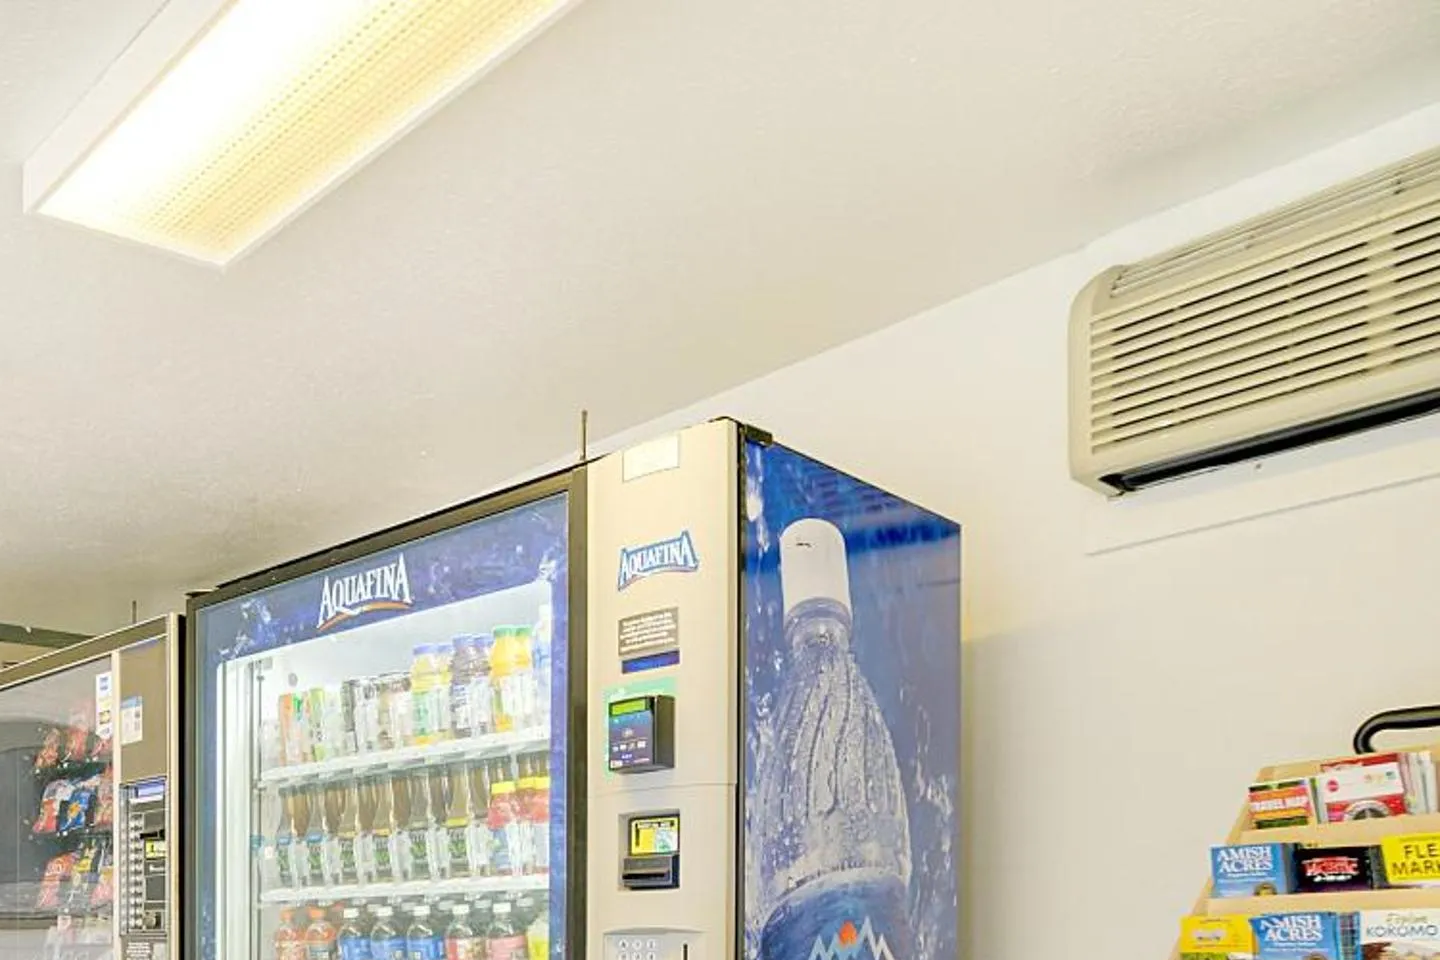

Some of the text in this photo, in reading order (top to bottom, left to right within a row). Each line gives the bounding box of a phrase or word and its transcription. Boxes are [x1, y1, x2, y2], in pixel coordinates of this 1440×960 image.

[619, 530, 698, 591] AQUAFINA
[317, 552, 413, 629] AQUAFINA
[1217, 846, 1272, 861] AMISH
[1404, 846, 1440, 859] FLE
[1219, 858, 1273, 873] ACRES
[1260, 915, 1321, 930] AMISH
[1265, 928, 1323, 943] ACRES
[1366, 924, 1438, 939] KOKOMO
